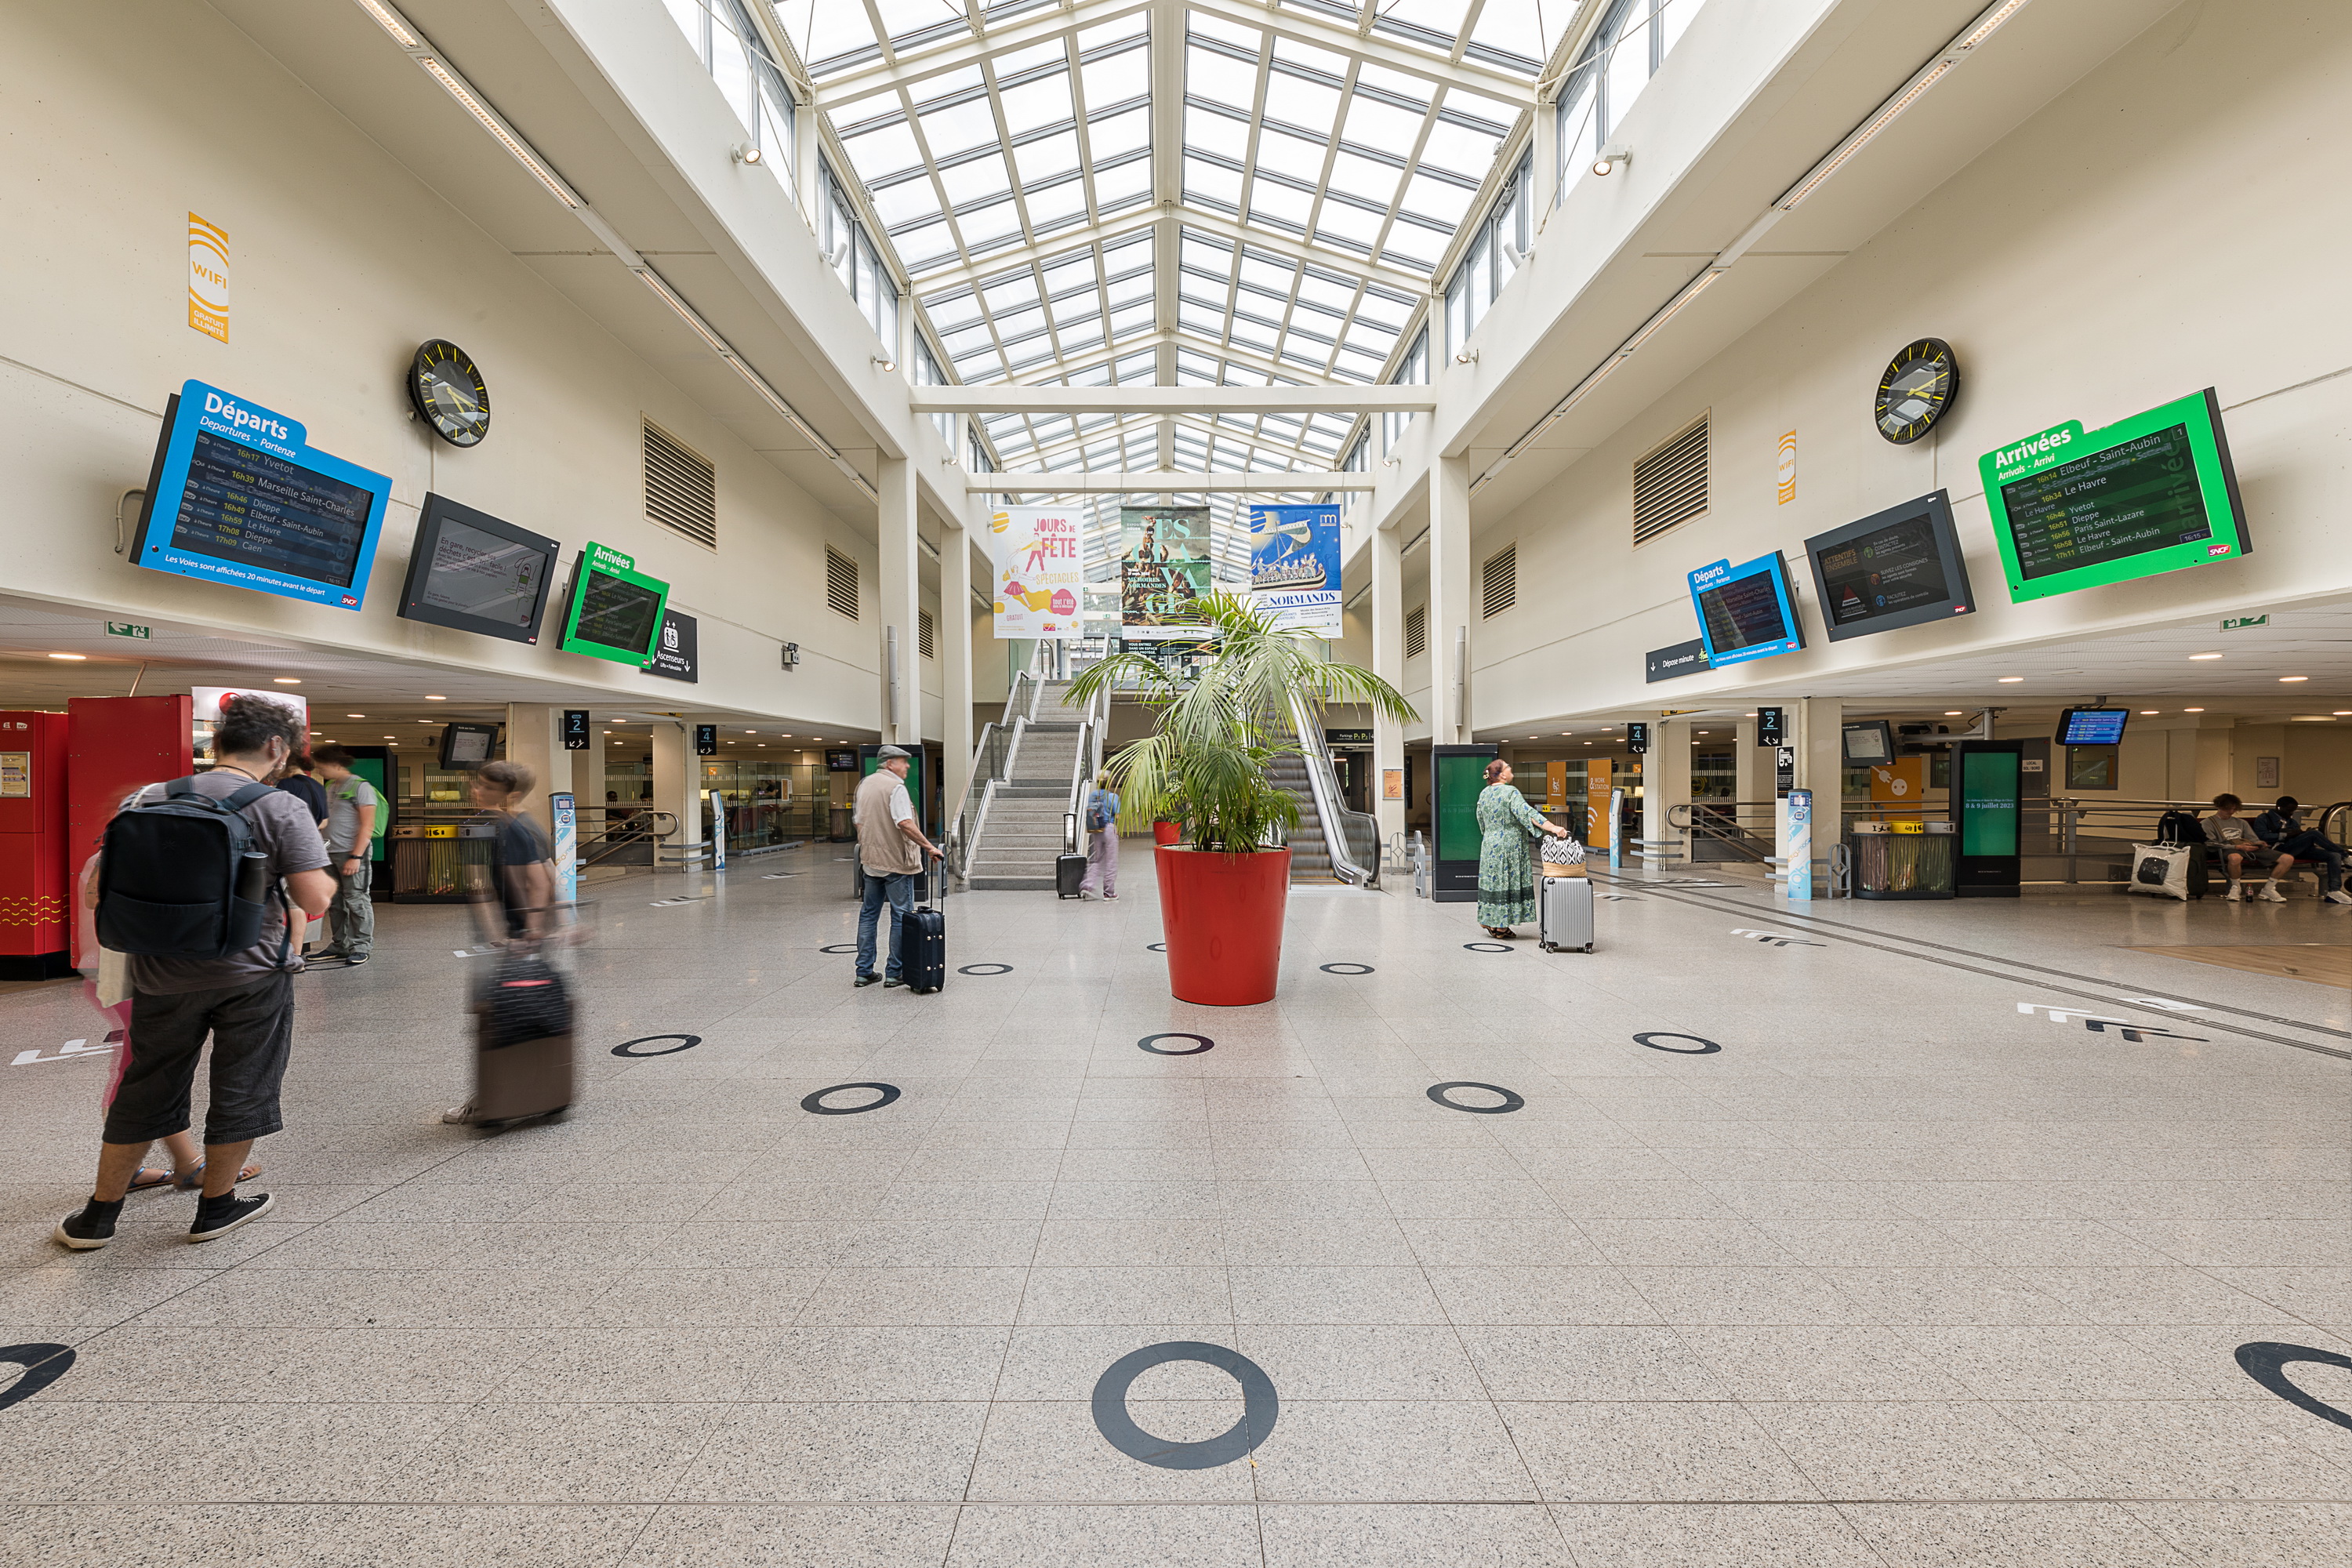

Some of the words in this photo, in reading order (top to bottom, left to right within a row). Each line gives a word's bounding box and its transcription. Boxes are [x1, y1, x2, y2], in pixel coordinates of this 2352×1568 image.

[192, 260, 227, 289] WIFI
[194, 310, 225, 329] GRATUIT
[194, 318, 225, 338] ILLIMITÉ
[205, 392, 288, 441] Départs
[200, 416, 251, 441] Departures
[260, 438, 296, 458] Partenze
[1996, 429, 2072, 469] Arrivées
[238, 448, 260, 462] 16h17
[264, 456, 296, 475] Yvetot
[1779, 459, 1795, 472] WIFI
[1998, 464, 2025, 481] Arrivals
[2034, 453, 2055, 469] Arrivi
[2037, 472, 2058, 485] 16h14
[2060, 458, 2090, 477] Elbeuf
[2099, 436, 2161, 461] Saint-Aubin
[231, 470, 255, 485] 16h39
[258, 477, 299, 499] Marseille
[300, 491, 355, 519] Saint-Charles
[2042, 491, 2062, 503] 16h34
[2065, 486, 2077, 495] Le
[2078, 476, 2107, 492] Havre
[227, 492, 249, 504] 16h46
[252, 499, 281, 515] Dieppe
[2024, 508, 2034, 517] Le
[2034, 503, 2056, 514] Havre
[2046, 510, 2065, 521] 16h46
[2068, 501, 2095, 514] Yvetot
[221, 514, 243, 526] 16h59
[248, 521, 257, 530] Le
[259, 523, 281, 536] Havre
[224, 503, 245, 514] 16h49
[251, 509, 276, 526] Elbeuf
[281, 521, 324, 538] Saint-Aubin
[1033, 518, 1066, 533] JOURS
[1155, 518, 1192, 540] ES
[2049, 521, 2067, 532] 16h51
[2071, 510, 2100, 524] Dieppe
[2050, 529, 2071, 541] 16h56
[2074, 524, 2093, 535] Paris
[2094, 510, 2144, 532] Saint-Lazare
[216, 535, 238, 547] 17h09
[242, 541, 263, 554] Caen
[219, 524, 240, 537] 17h08
[245, 530, 274, 546] Dieppe
[1041, 533, 1076, 557] FÊTE
[2053, 539, 2073, 550] 16h58
[2077, 535, 2085, 544] Le
[2087, 530, 2111, 542] Havre
[2056, 550, 2075, 560] 17h11
[2079, 541, 2104, 554] Elbeuf
[2111, 528, 2161, 546] Saint-Aubin
[2183, 533, 2201, 542] 16:15
[441, 537, 449, 546] En
[449, 542, 465, 552] gare,
[466, 546, 488, 557] recycler
[1131, 543, 1194, 564] CLA
[1874, 539, 1899, 552] CONTACTEZ
[2209, 546, 2230, 556] SNCF
[438, 545, 463, 558] déchets
[463, 553, 477, 563] c'est
[489, 561, 504, 571] facile
[592, 559, 607, 571] Arrivals
[593, 546, 631, 570] Arrivées
[1824, 549, 1857, 565] ATTENTIFS
[1825, 557, 1859, 572] ENSEMBLE
[1880, 565, 1895, 575] SUIVEZ
[1902, 557, 1929, 570] CONSIGNES
[165, 554, 178, 564] Les
[179, 557, 198, 568] Voies
[199, 562, 216, 572] sont
[216, 566, 246, 579] affichées
[247, 572, 256, 580] 20
[256, 575, 282, 587] minutes
[282, 581, 299, 591] avant
[299, 583, 307, 592] le
[306, 586, 325, 597] départ
[1035, 572, 1080, 586] SPECTACLES
[1160, 567, 1200, 589] VA
[1693, 565, 1725, 585] Départs
[1696, 581, 1714, 592] Departures
[1716, 575, 1731, 585] Partenze
[342, 596, 358, 607] SNCF
[1145, 593, 1185, 614] GE
[1270, 592, 1336, 606] NORMANDS
[1886, 590, 1906, 600] FACILITEZ
[657, 650, 685, 665] Ascenseurs
[1663, 658, 1679, 669] Dépose
[1678, 655, 1694, 665] minute
[573, 719, 581, 731] 2
[1766, 716, 1774, 728] 2
[703, 731, 710, 741] 4
[1634, 730, 1641, 739] 4
[1981, 801, 1999, 810] juillet
